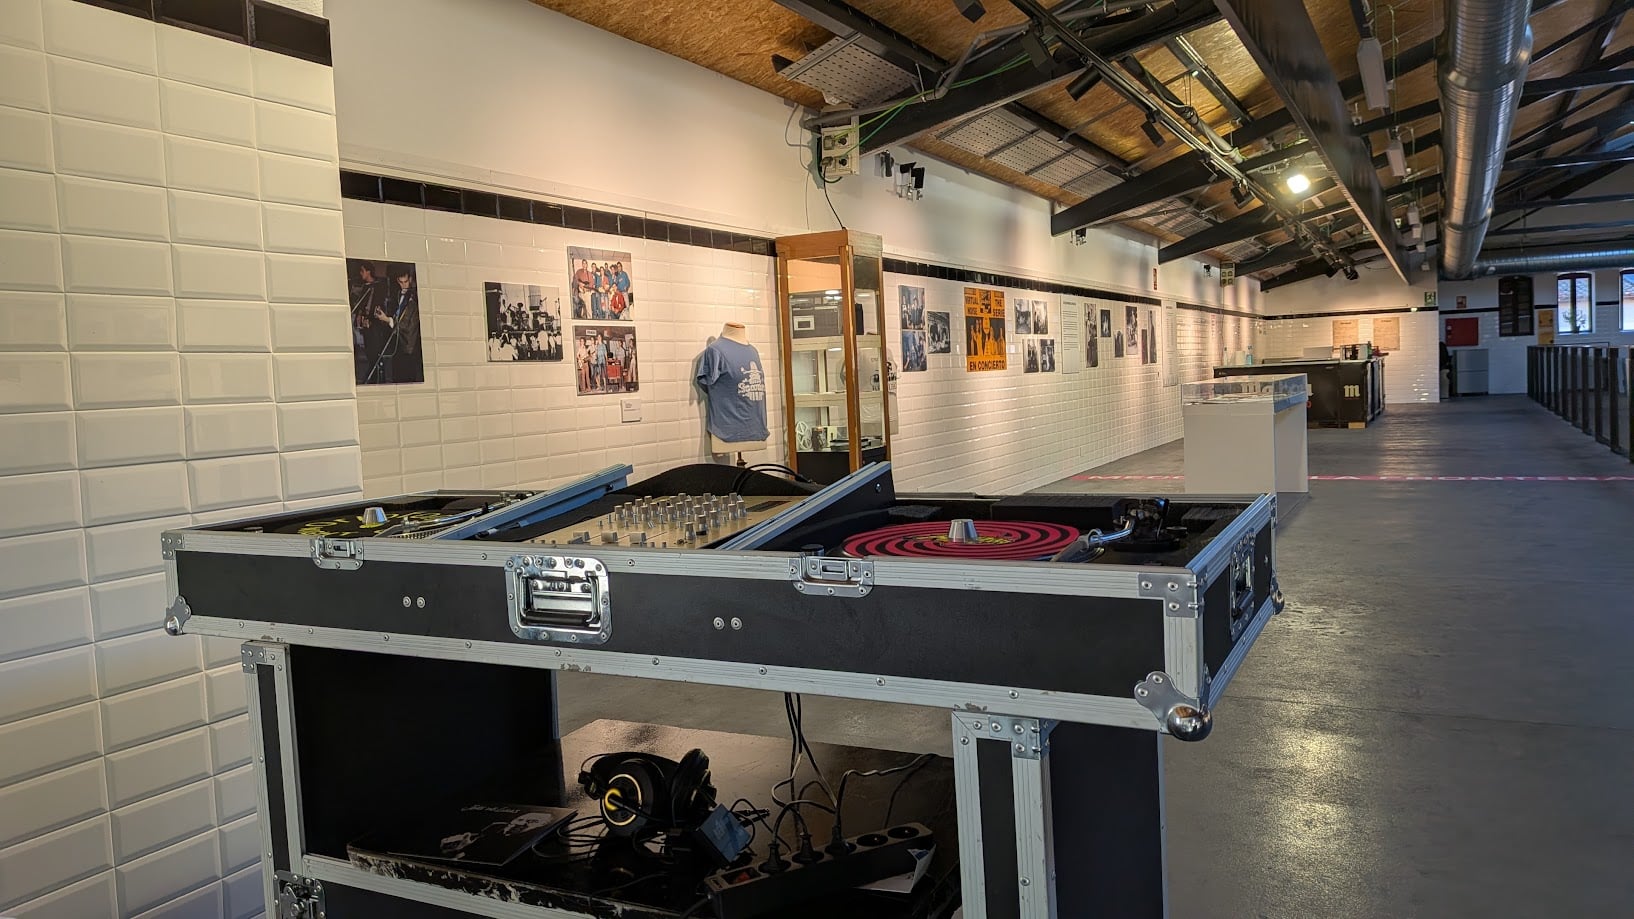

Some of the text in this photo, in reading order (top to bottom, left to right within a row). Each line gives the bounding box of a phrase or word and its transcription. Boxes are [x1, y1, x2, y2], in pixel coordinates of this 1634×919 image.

[965, 296, 979, 305] VIRTUAL
[969, 360, 1005, 371] EN CONCIERTO
